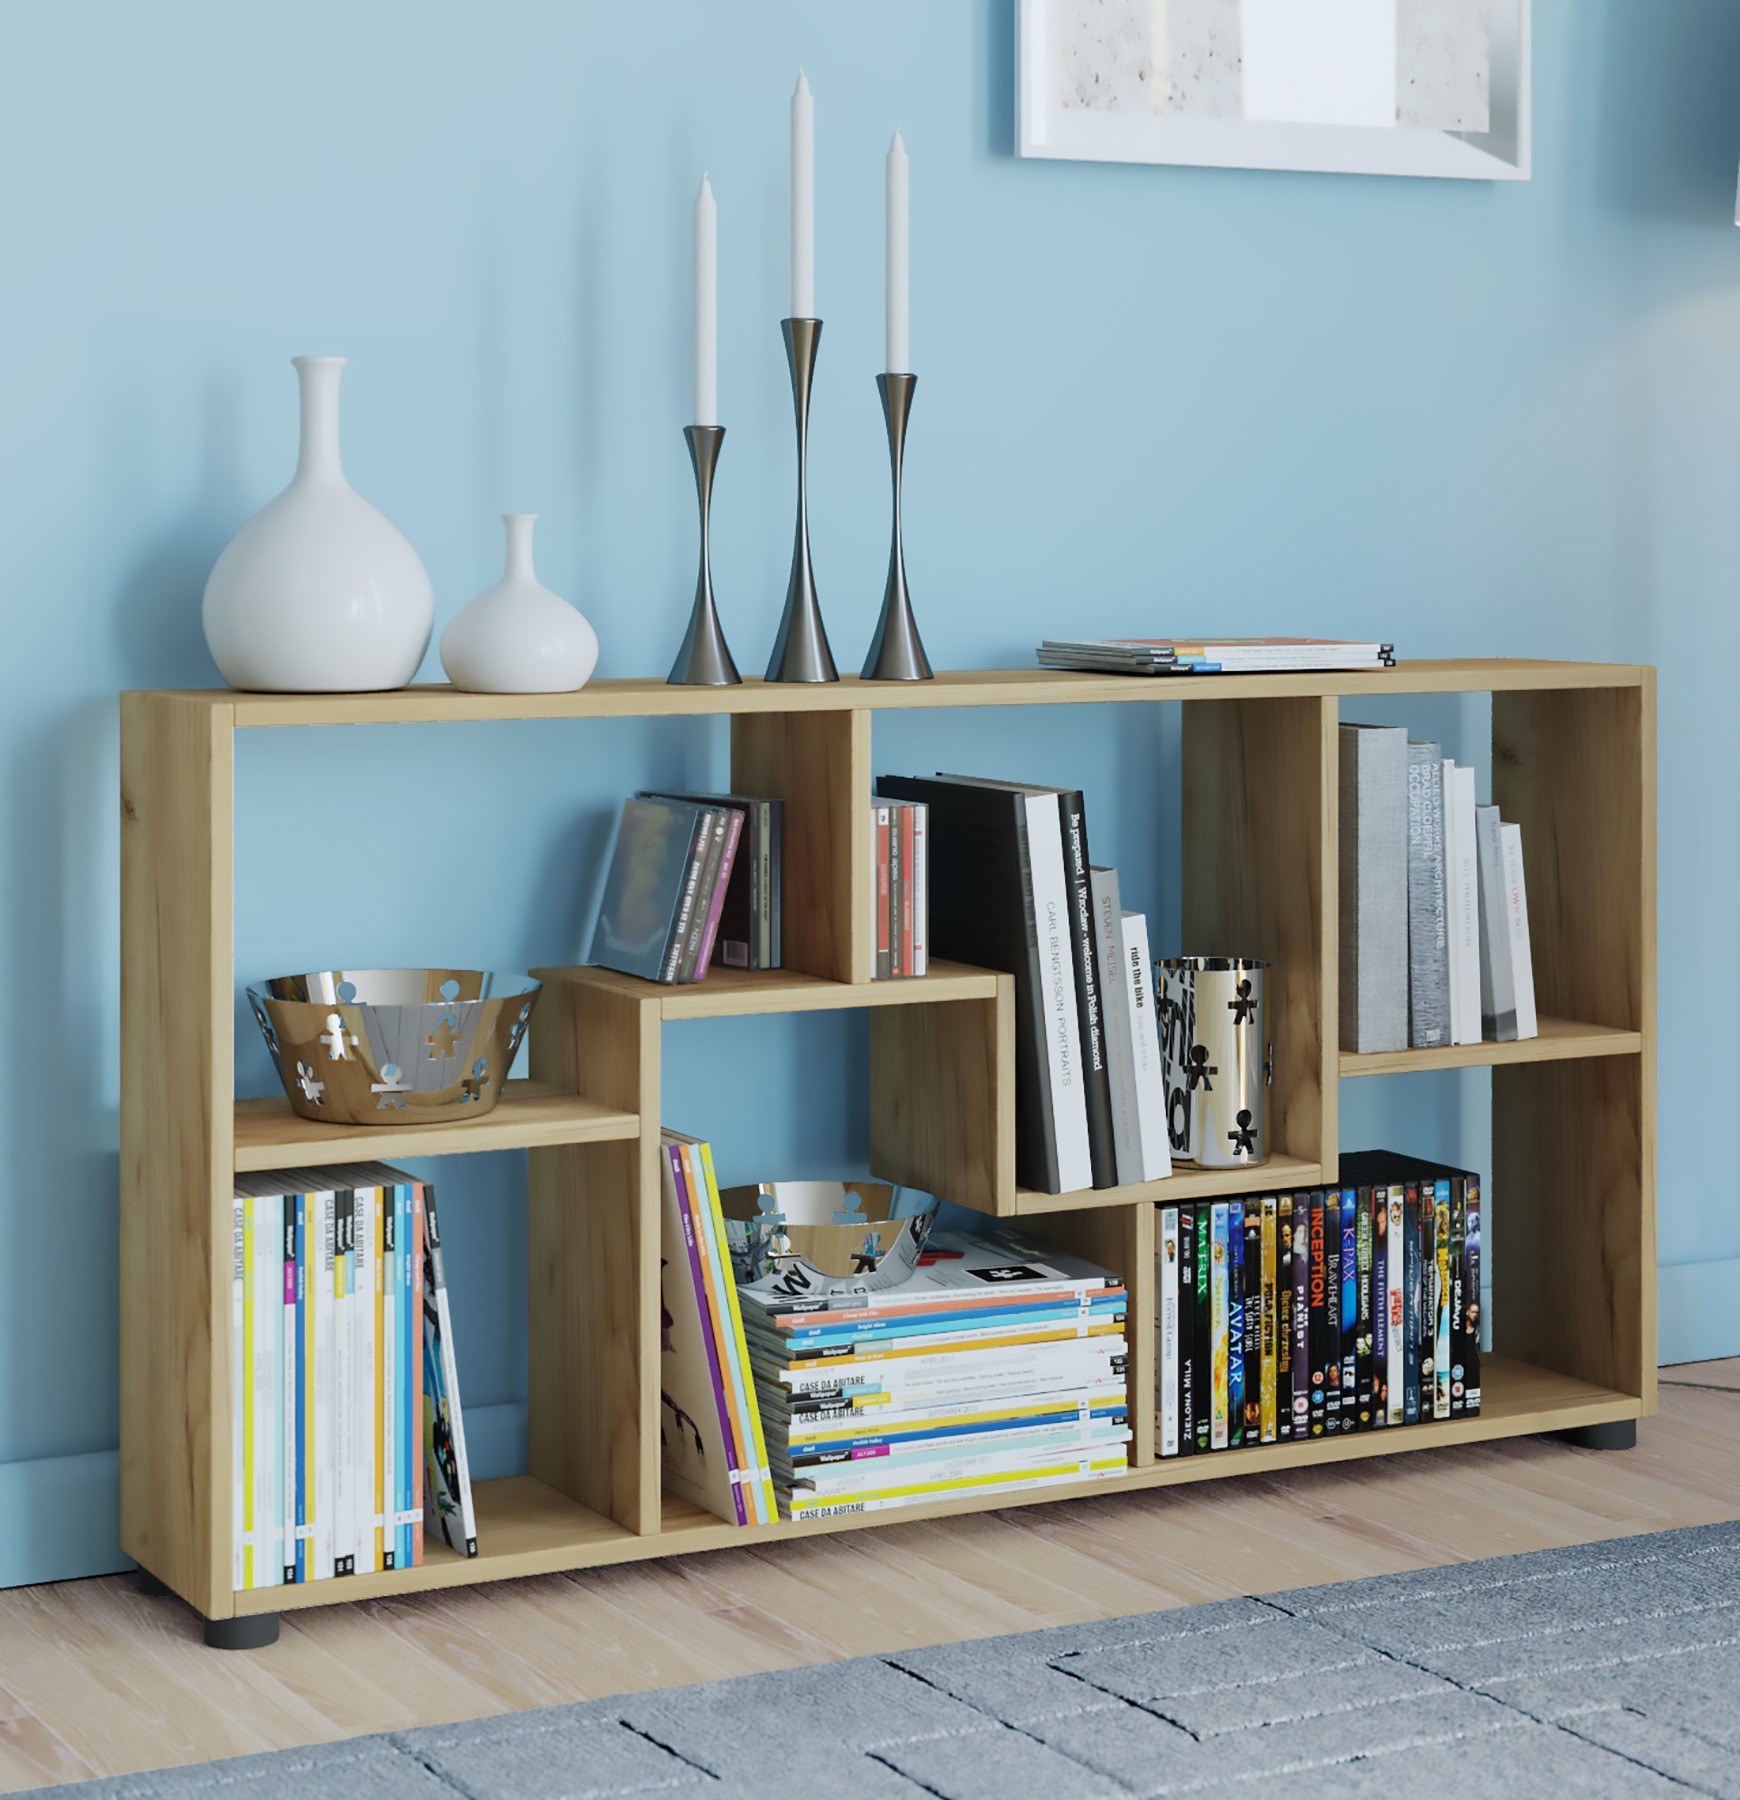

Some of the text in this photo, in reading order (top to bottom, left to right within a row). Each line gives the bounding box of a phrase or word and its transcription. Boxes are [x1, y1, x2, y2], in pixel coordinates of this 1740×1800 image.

[1431, 763, 1440, 805] ALLIED
[1071, 813, 1080, 828] Be
[1409, 764, 1421, 845] OCCUPATION
[1422, 764, 1433, 859] BRAD CLOEPFIL
[1070, 828, 1085, 875] prepared
[1102, 896, 1113, 939] STEVEN
[1435, 855, 1445, 949] ARCHITECTURE
[1511, 887, 1520, 913] OWN
[1082, 938, 1094, 984] welcome
[1106, 945, 1117, 984] MEISEL
[1130, 947, 1140, 968] ride
[1132, 969, 1142, 985] the
[1046, 901, 1071, 1086] CARL BENGTSSON PORTRAITS
[1086, 984, 1096, 995] in
[1134, 987, 1144, 1008] bike
[1087, 996, 1098, 1025] Polish
[1090, 1026, 1102, 1071] diamond
[325, 1199, 334, 1220] CASE
[355, 1196, 364, 1218] CASE
[355, 1220, 364, 1232] DA
[234, 1207, 244, 1282] CASE DA ABITARE
[325, 1223, 334, 1235] DA
[325, 1236, 334, 1272] ABITARE
[355, 1233, 364, 1269] ABITARE
[1197, 1220, 1208, 1295] MATRIX
[1311, 1207, 1324, 1308] INCEPTION
[1342, 1227, 1355, 1283] K-PAX
[1360, 1212, 1370, 1320] GREEN STREET HOOLIGANS
[1328, 1254, 1340, 1327] BRAVEHEART
[1377, 1259, 1385, 1357] THE FIFTH ELEMENT
[1264, 1282, 1273, 1356] PULP FICTION
[920, 1357, 938, 1365] APRIL
[1229, 1301, 1243, 1387] AVATAR
[800, 1375, 865, 1393] CASE DA ABITARE
[1183, 1359, 1192, 1440] ZIELONA MILA
[799, 1407, 865, 1424] CASE DA ABITARE
[927, 1406, 961, 1417] SEPTEMBER
[800, 1502, 865, 1521] CASE DA ABITARE
